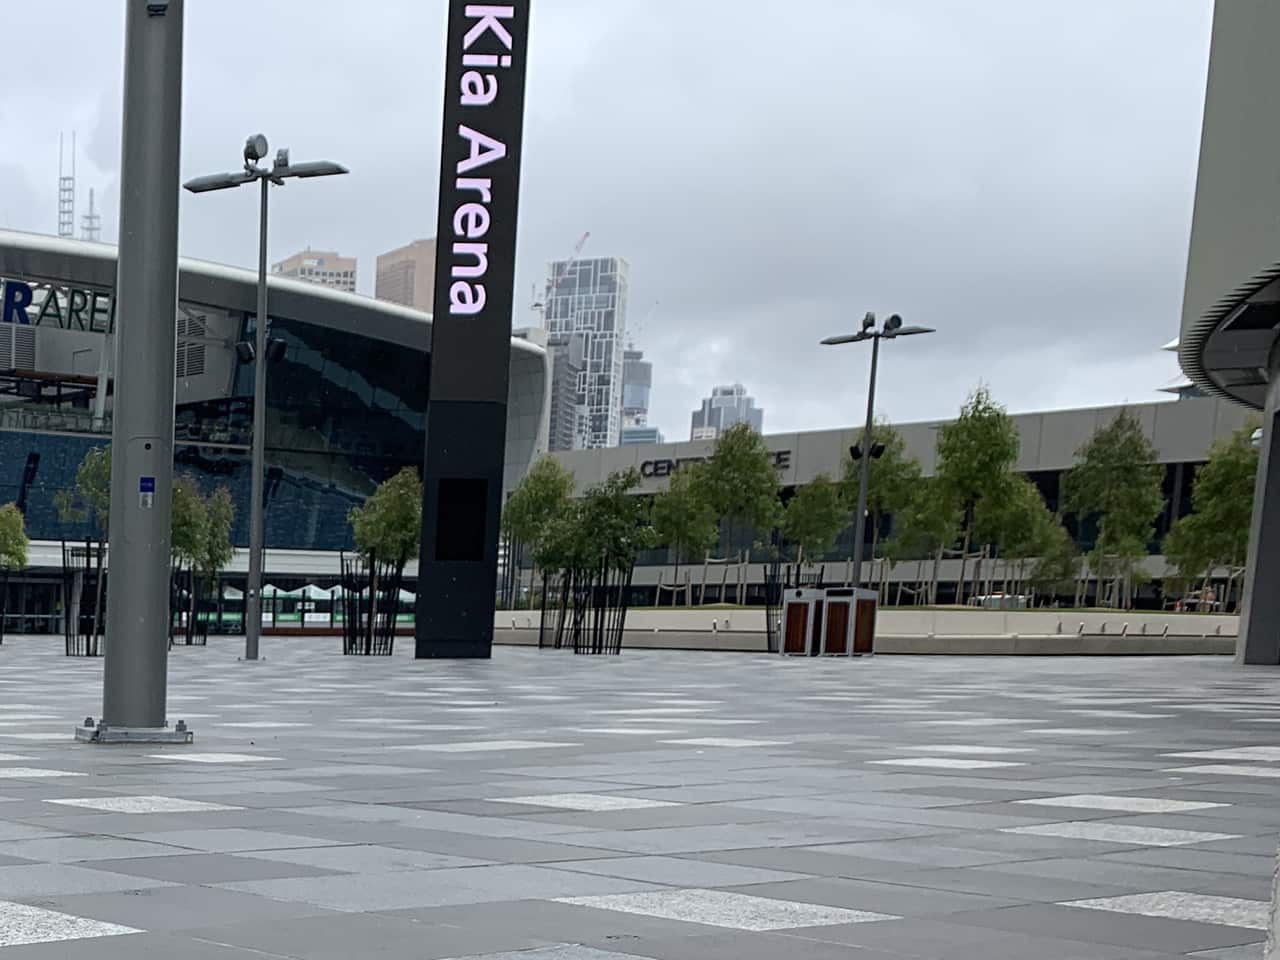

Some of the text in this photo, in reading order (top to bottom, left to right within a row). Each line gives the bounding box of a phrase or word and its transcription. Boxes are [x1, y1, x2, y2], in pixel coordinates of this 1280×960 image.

[449, 5, 514, 315] Kia Arena
[36, 288, 117, 334] ARE
